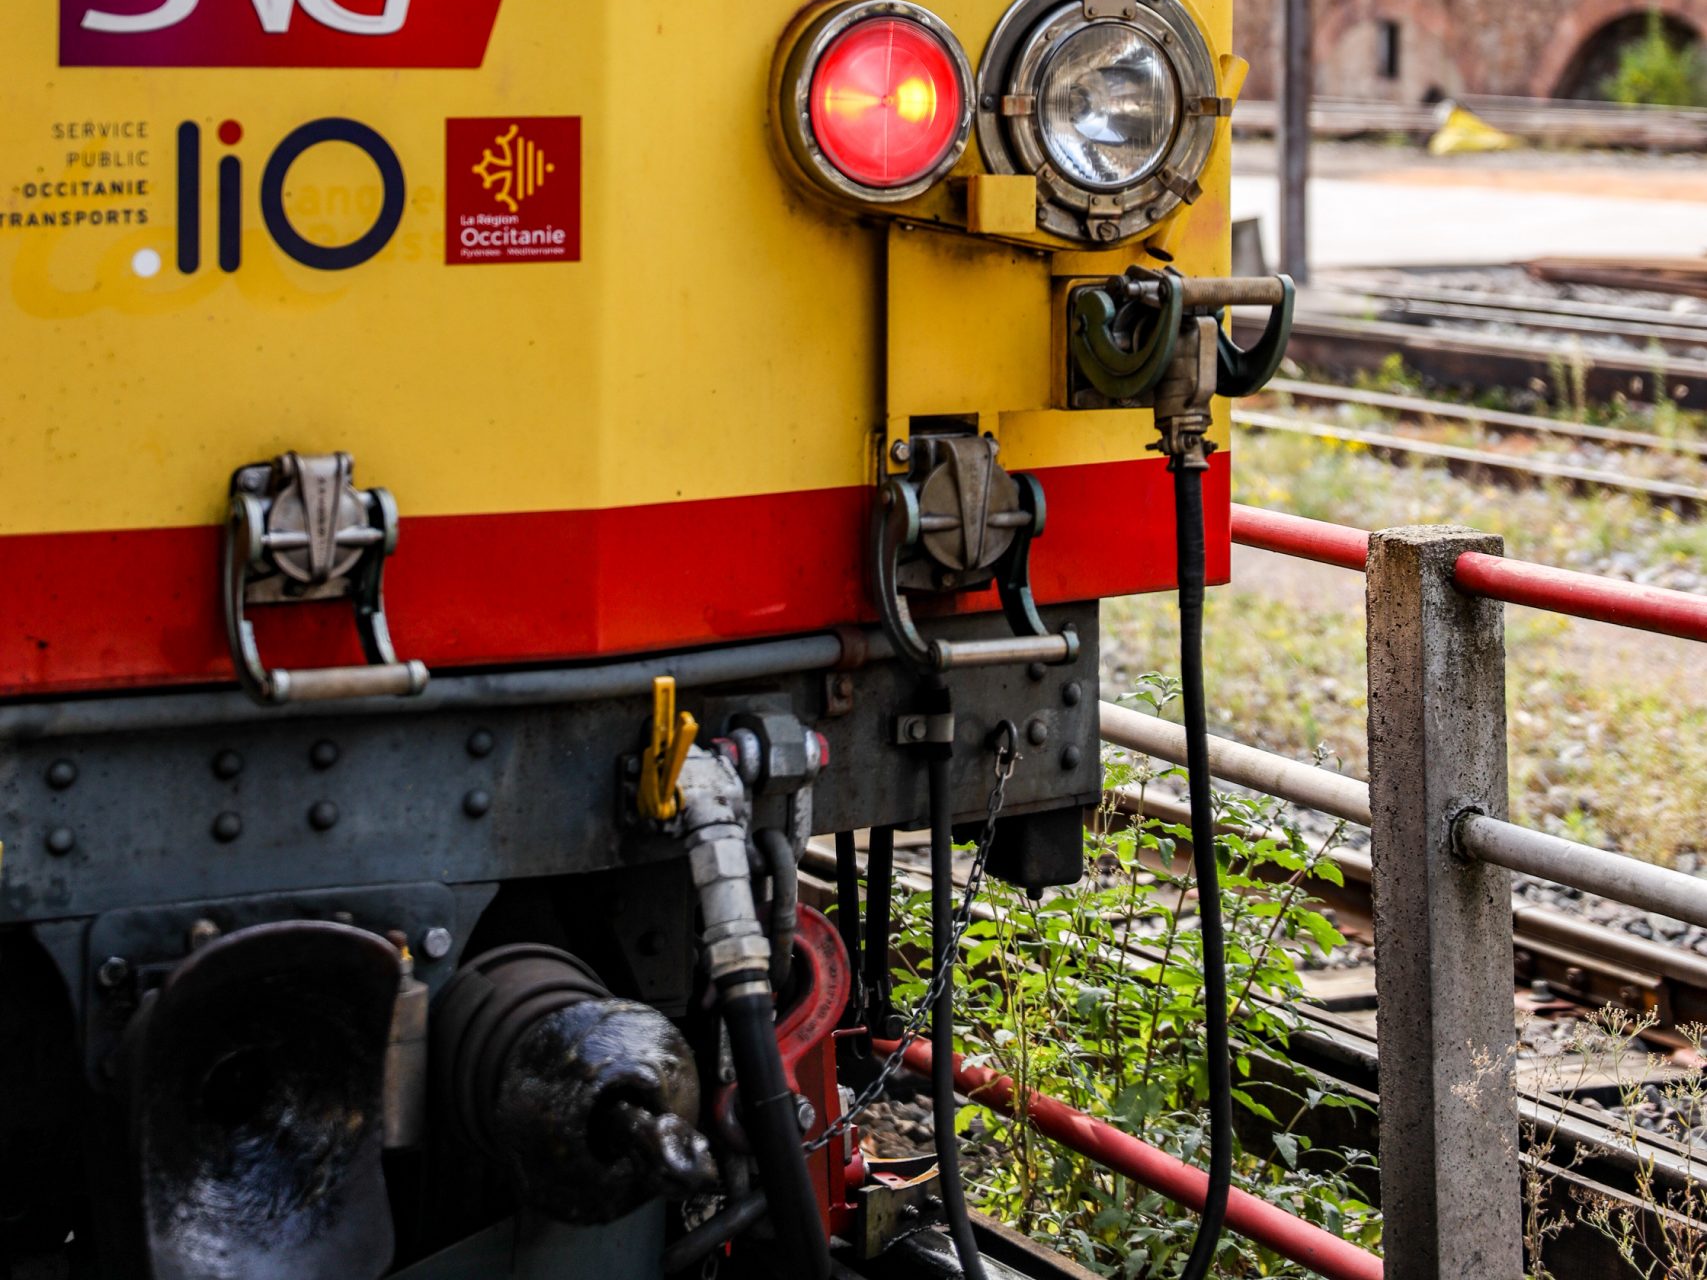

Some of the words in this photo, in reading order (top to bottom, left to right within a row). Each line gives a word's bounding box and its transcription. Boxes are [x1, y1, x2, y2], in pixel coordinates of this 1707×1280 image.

[51, 120, 149, 140] SERVICE
[65, 150, 149, 168] PUBLIC
[22, 179, 149, 199] OCCITANIE
[0, 208, 149, 228] TRANSPORTS
[460, 214, 475, 226] La
[460, 225, 566, 246] Occitanie
